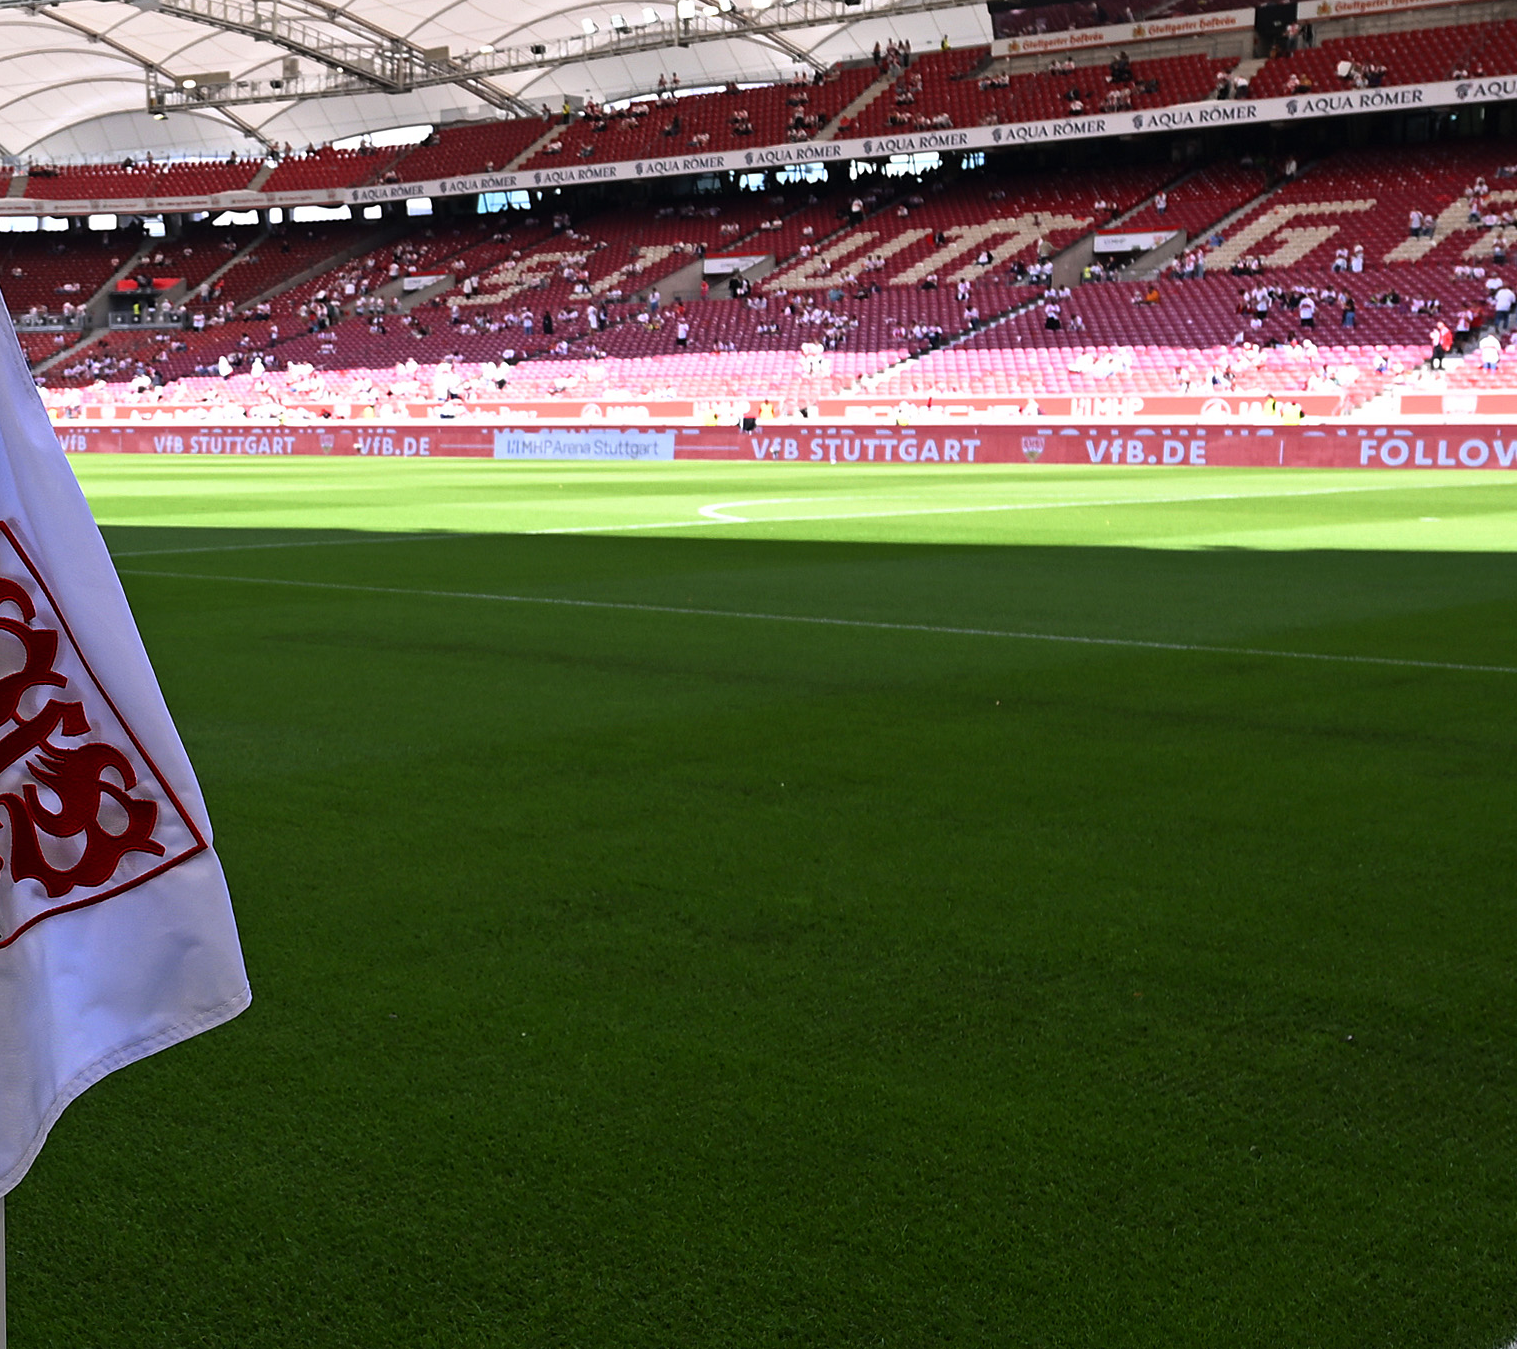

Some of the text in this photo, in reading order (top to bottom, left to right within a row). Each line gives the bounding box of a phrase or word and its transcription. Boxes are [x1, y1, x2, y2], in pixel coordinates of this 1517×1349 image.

[1303, 88, 1423, 114] AQUA RÖMER
[1148, 104, 1257, 128] AQUA RÖMER
[1006, 118, 1106, 141] AQUA RÖMER
[876, 131, 968, 154] AQUA RÖMER
[645, 154, 725, 174] AQUA RÖMER
[756, 143, 841, 165] AQUA RÖMER
[449, 175, 517, 192] AQUA RÖMER
[544, 166, 617, 184] AQUA RÖMER
[361, 185, 425, 201] AQUA RÖMER
[154, 436, 295, 454] VfB STUTTGART
[358, 436, 429, 456] VfB.DE
[593, 439, 660, 459] Stuttgart
[751, 438, 981, 461] VfB STUTTGART
[1085, 439, 1206, 465] VfB.DE
